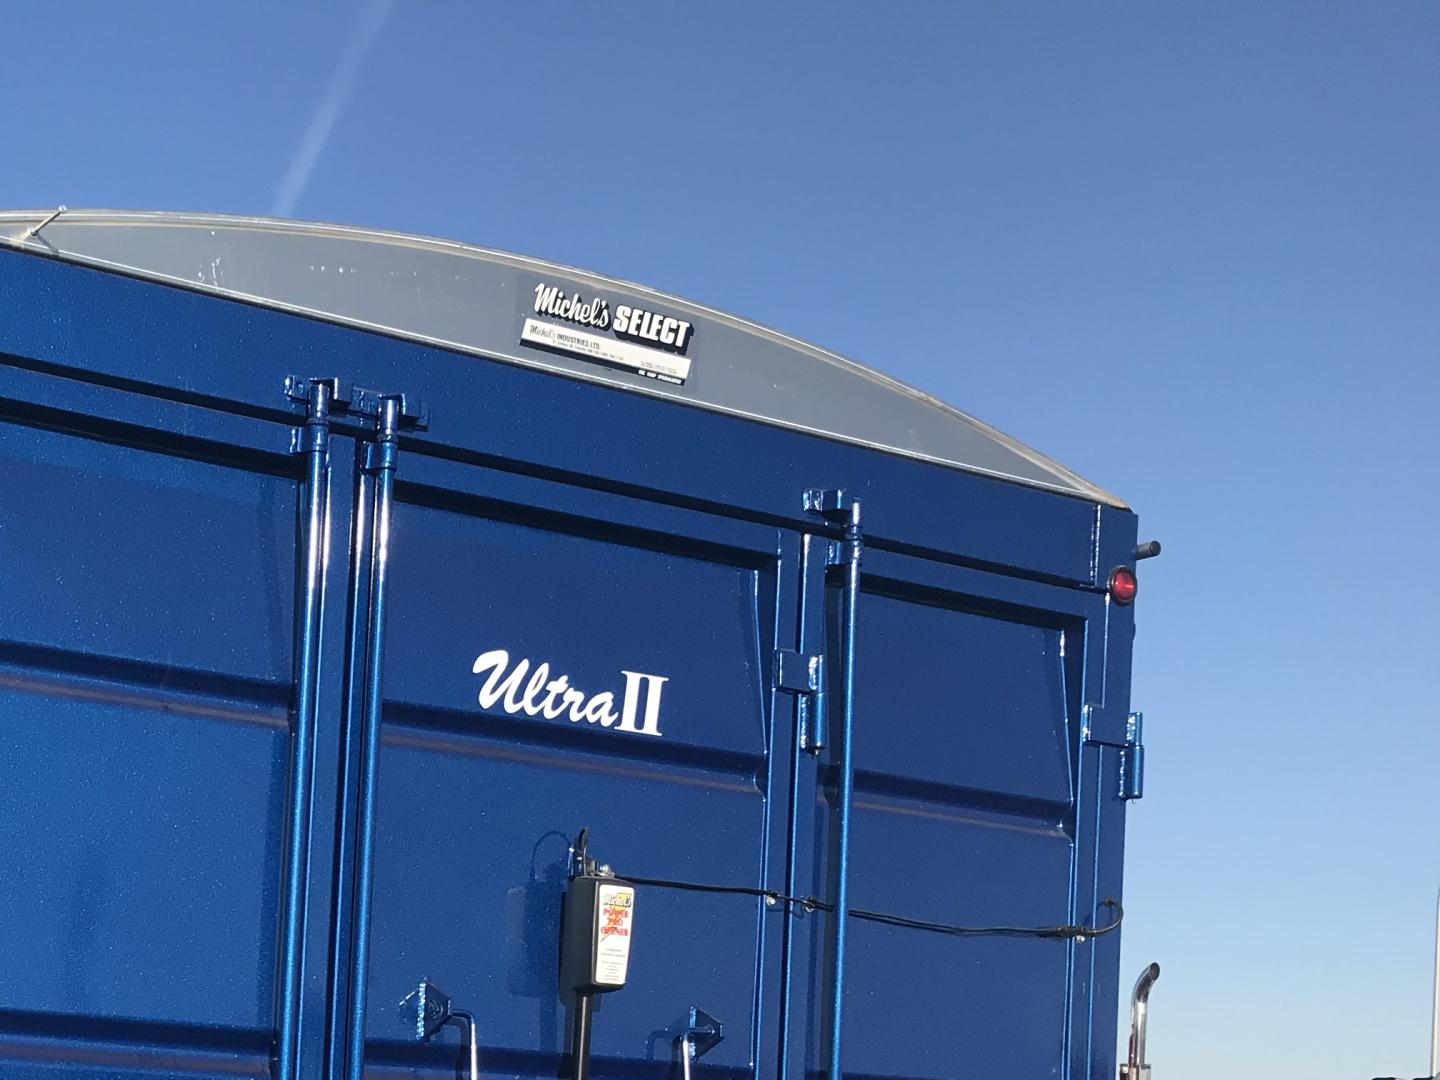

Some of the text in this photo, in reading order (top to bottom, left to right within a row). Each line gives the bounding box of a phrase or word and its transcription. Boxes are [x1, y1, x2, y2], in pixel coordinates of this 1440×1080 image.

[534, 283, 610, 331] Michel's
[613, 304, 694, 354] SELECT
[472, 650, 619, 727] Ultra
